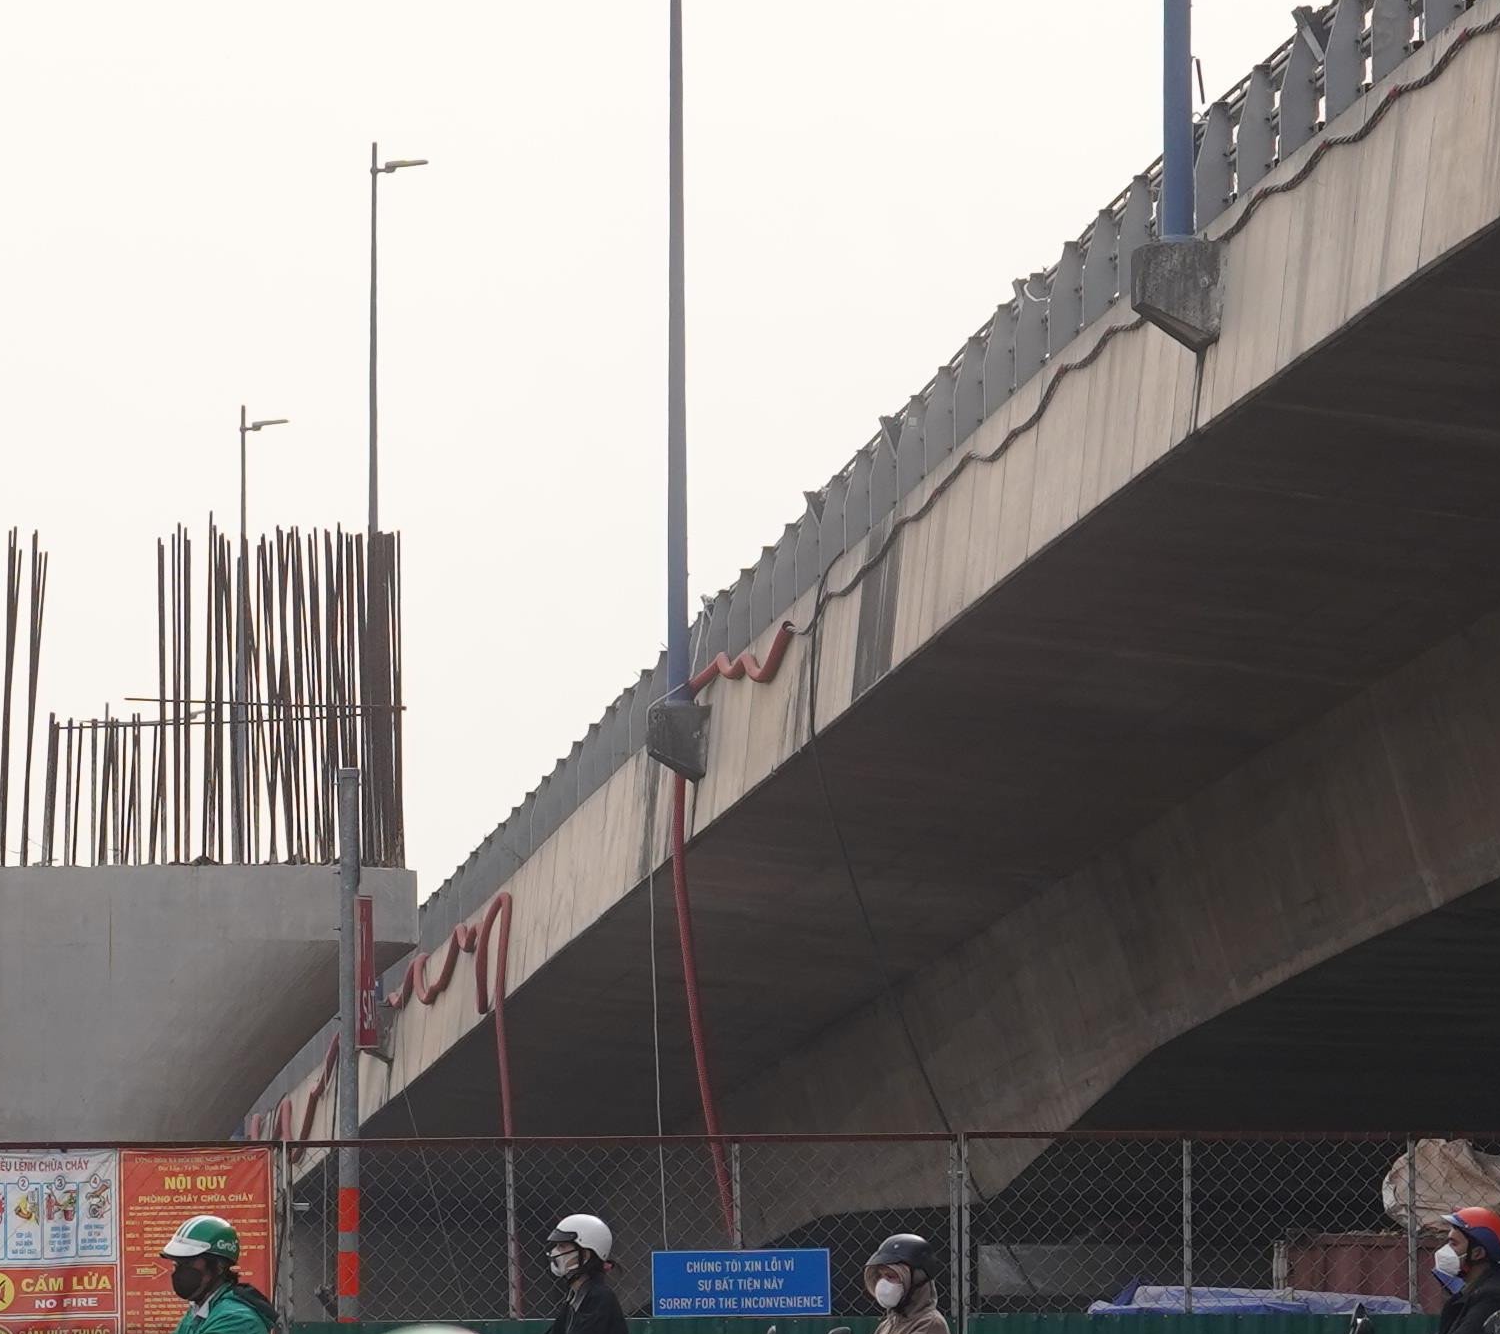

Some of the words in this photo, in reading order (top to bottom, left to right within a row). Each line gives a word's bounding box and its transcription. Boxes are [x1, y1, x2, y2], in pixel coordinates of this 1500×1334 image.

[21, 1179, 26, 1188] 2
[57, 1179, 62, 1187] 3
[92, 1176, 97, 1185] 4
[165, 1174, 191, 1192] NỘI
[196, 1176, 227, 1191] QUY
[138, 1194, 170, 1203] PHÒNG
[217, 1239, 236, 1253] Grab
[686, 1259, 721, 1273] CHÚNG
[725, 1259, 742, 1273] TÔI
[744, 1260, 762, 1272] XIN
[765, 1256, 782, 1272] LỖI
[785, 1256, 795, 1271] VÌ
[21, 1274, 64, 1292] CẤM
[72, 1271, 112, 1290] LỬA
[697, 1278, 712, 1292] SỰ
[716, 1277, 734, 1291] BẤT
[737, 1276, 760, 1292] TIỆN
[764, 1275, 783, 1289] NÀY
[35, 1299, 57, 1308] NO
[63, 1298, 98, 1307] FIRE
[659, 1297, 692, 1309] SORRY
[695, 1297, 716, 1309] FOR
[719, 1297, 738, 1308] THE
[741, 1295, 824, 1308] INCONVENIENCE
